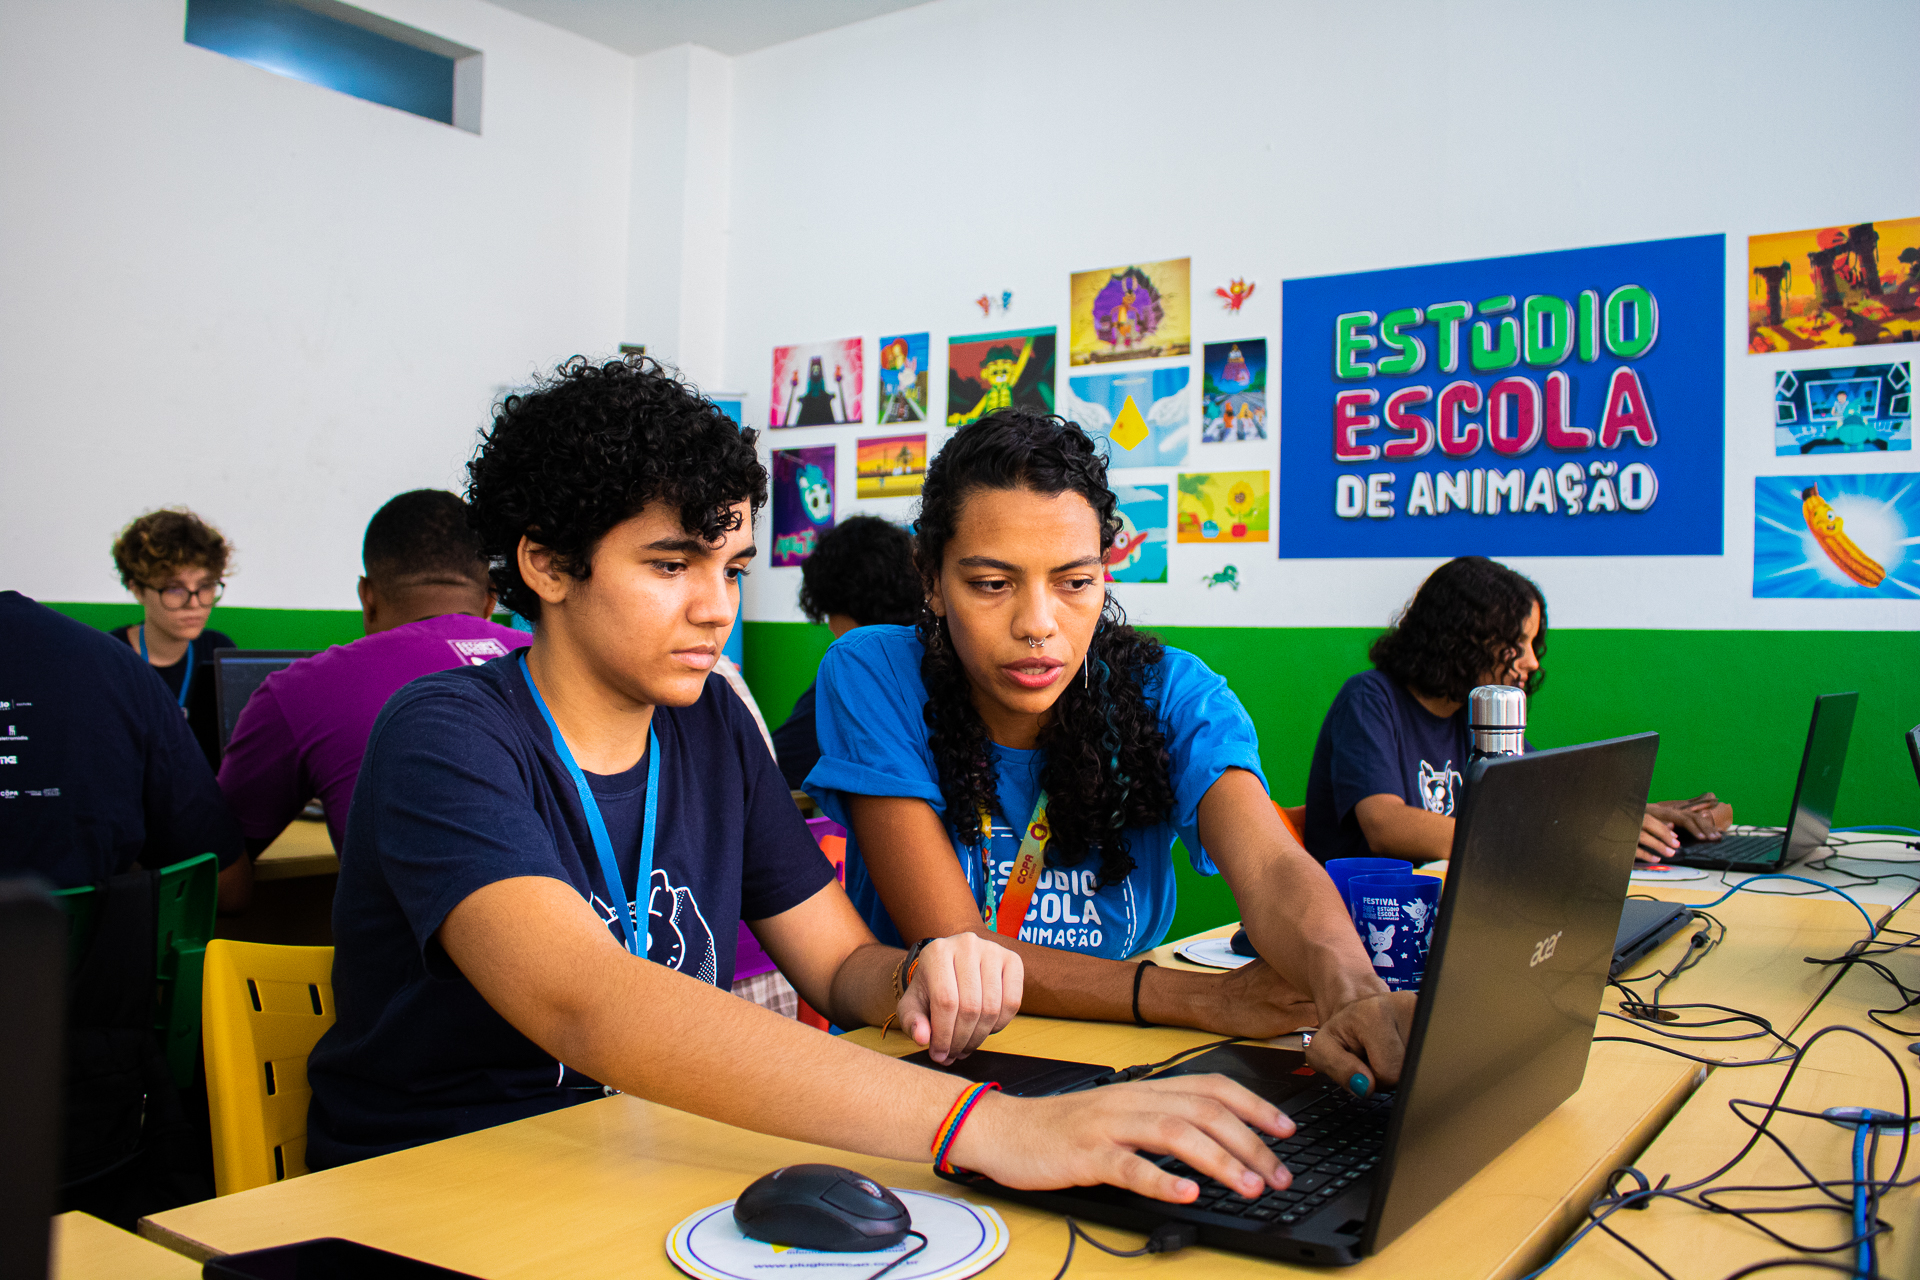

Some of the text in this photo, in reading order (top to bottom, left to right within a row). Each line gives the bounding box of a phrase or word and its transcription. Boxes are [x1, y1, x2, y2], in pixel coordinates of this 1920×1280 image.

[1334, 284, 1658, 379] ESTÚDIO
[1334, 366, 1657, 461] ESCOLA
[1335, 462, 1658, 518] DE ANIMAÇÃO
[1017, 854, 1034, 884] COPA
[1363, 897, 1399, 906] FESTIVAL
[1018, 925, 1102, 948] NIMAÇÃO
[1530, 931, 1562, 967] acer
